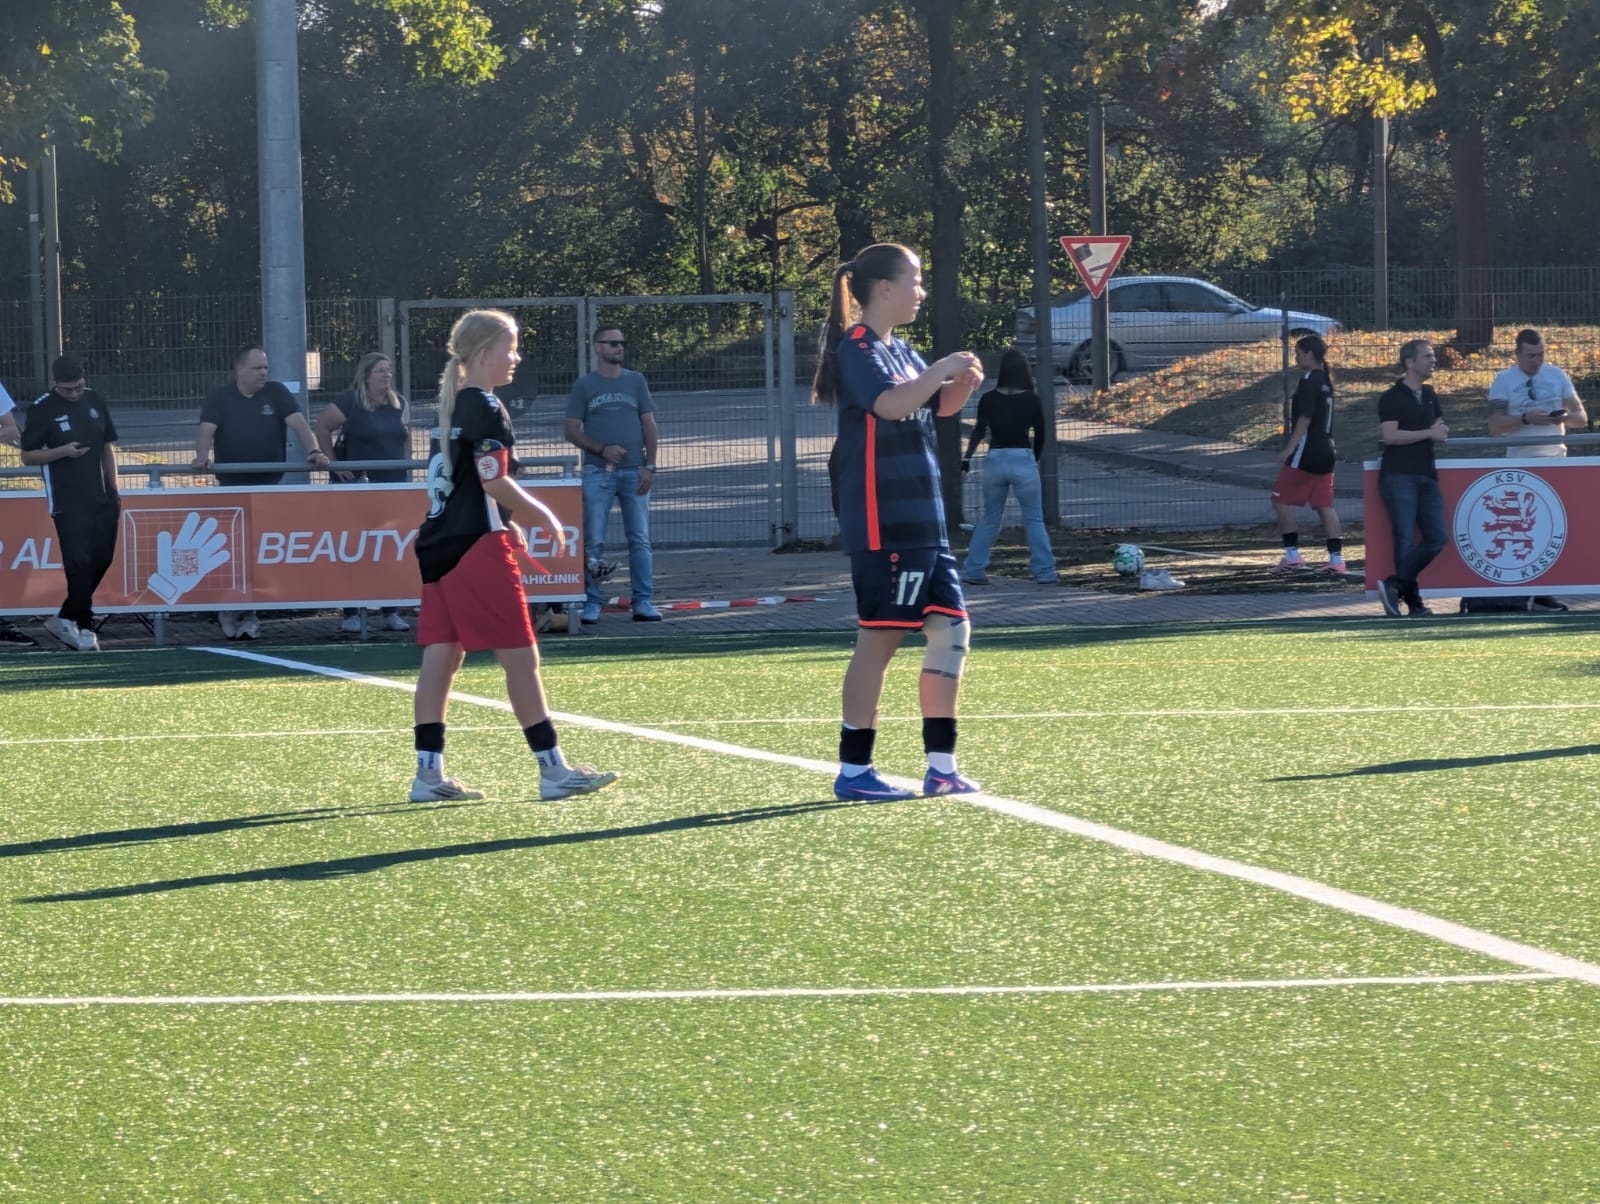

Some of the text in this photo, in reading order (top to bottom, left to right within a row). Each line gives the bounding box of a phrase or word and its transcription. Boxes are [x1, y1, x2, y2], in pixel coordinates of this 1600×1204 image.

[1495, 473, 1526, 484] KSV
[257, 529, 418, 564] BEAUTY
[1458, 532, 1563, 579] HESSEN KASSEL
[896, 571, 925, 606] 17
